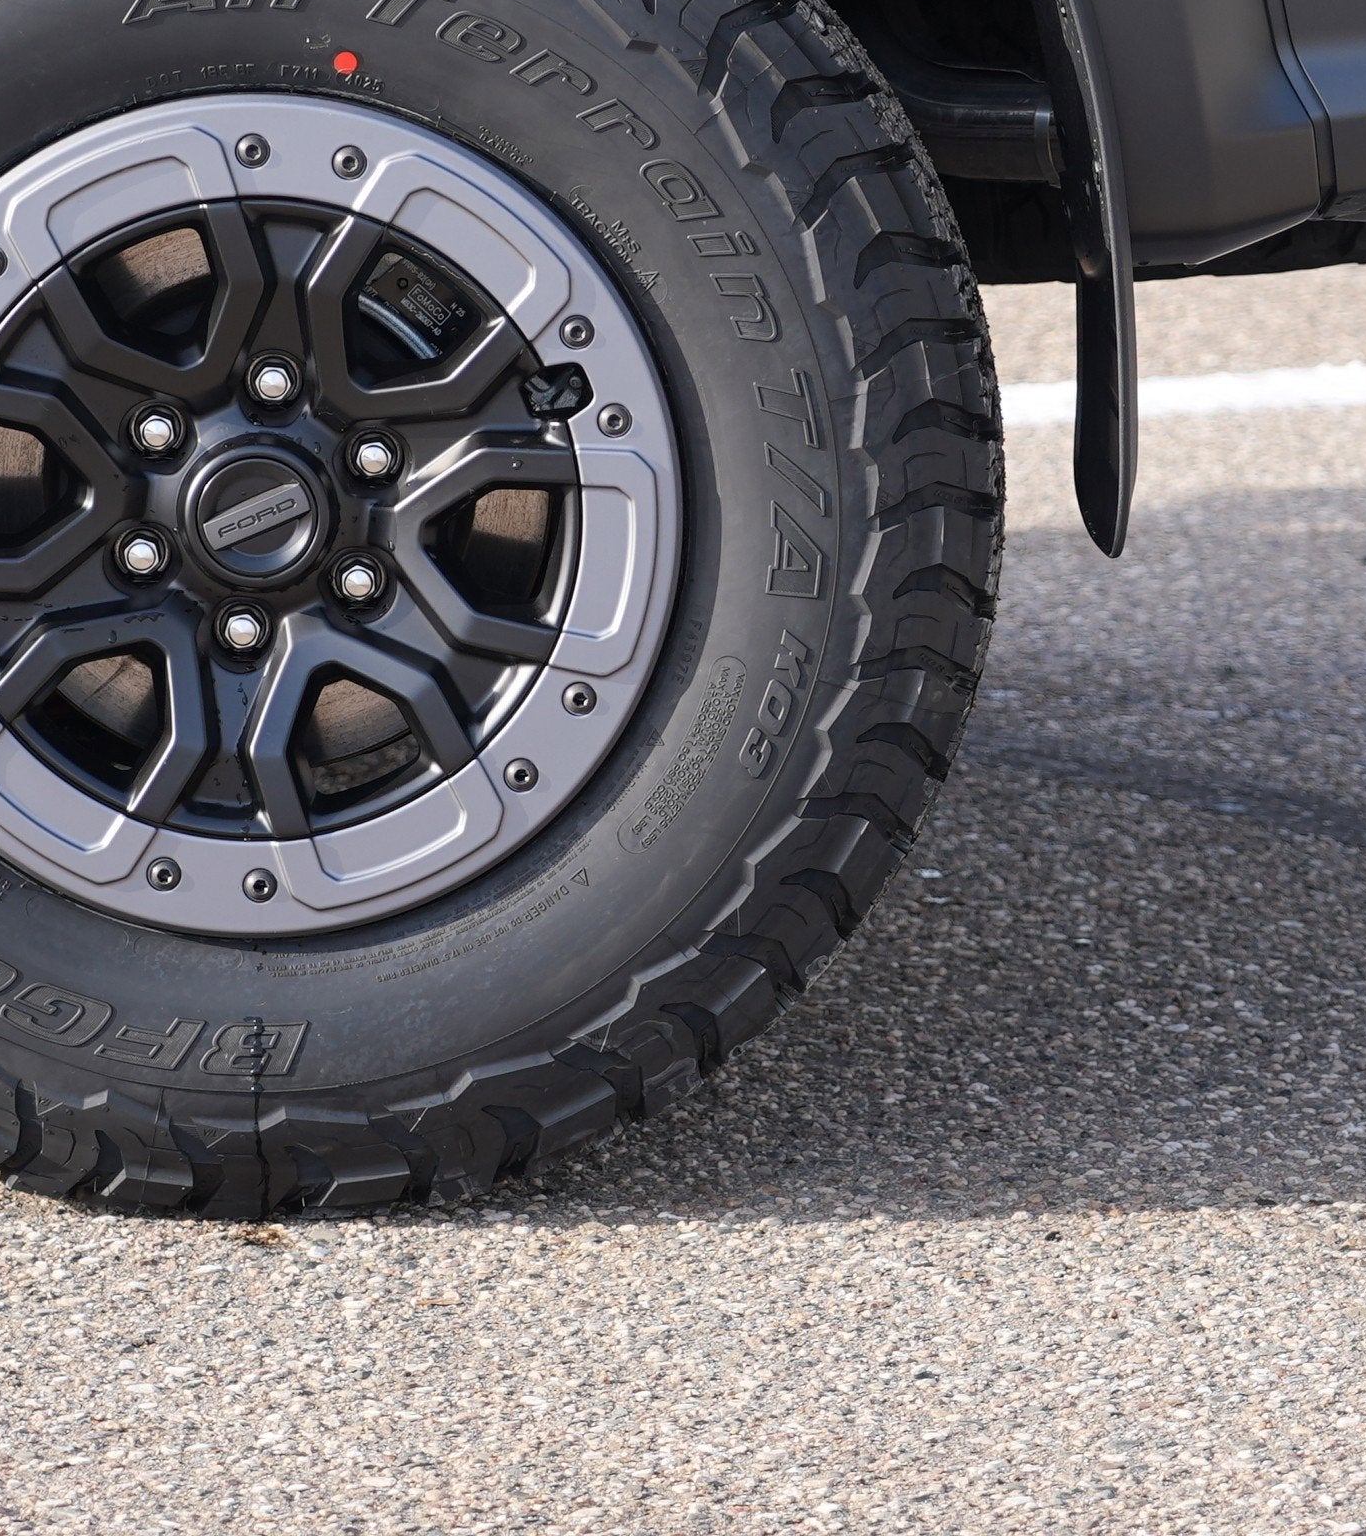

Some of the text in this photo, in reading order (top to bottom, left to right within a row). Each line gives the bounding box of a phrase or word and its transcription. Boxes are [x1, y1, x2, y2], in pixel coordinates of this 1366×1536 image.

[569, 195, 633, 266] TRACTION
[610, 218, 642, 255] M+S
[411, 287, 445, 321] FoMoCo
[753, 368, 826, 598] T/A
[216, 497, 298, 539] FORD
[706, 689, 723, 719] LOAD
[720, 695, 739, 726] LOAD
[739, 628, 809, 778] KO3
[692, 720, 711, 748] DUAL
[703, 726, 726, 763] SINGLE
[642, 782, 666, 811] COLD
[657, 792, 680, 820] COLD
[522, 882, 569, 923] DANGER
[508, 915, 522, 928] DO
